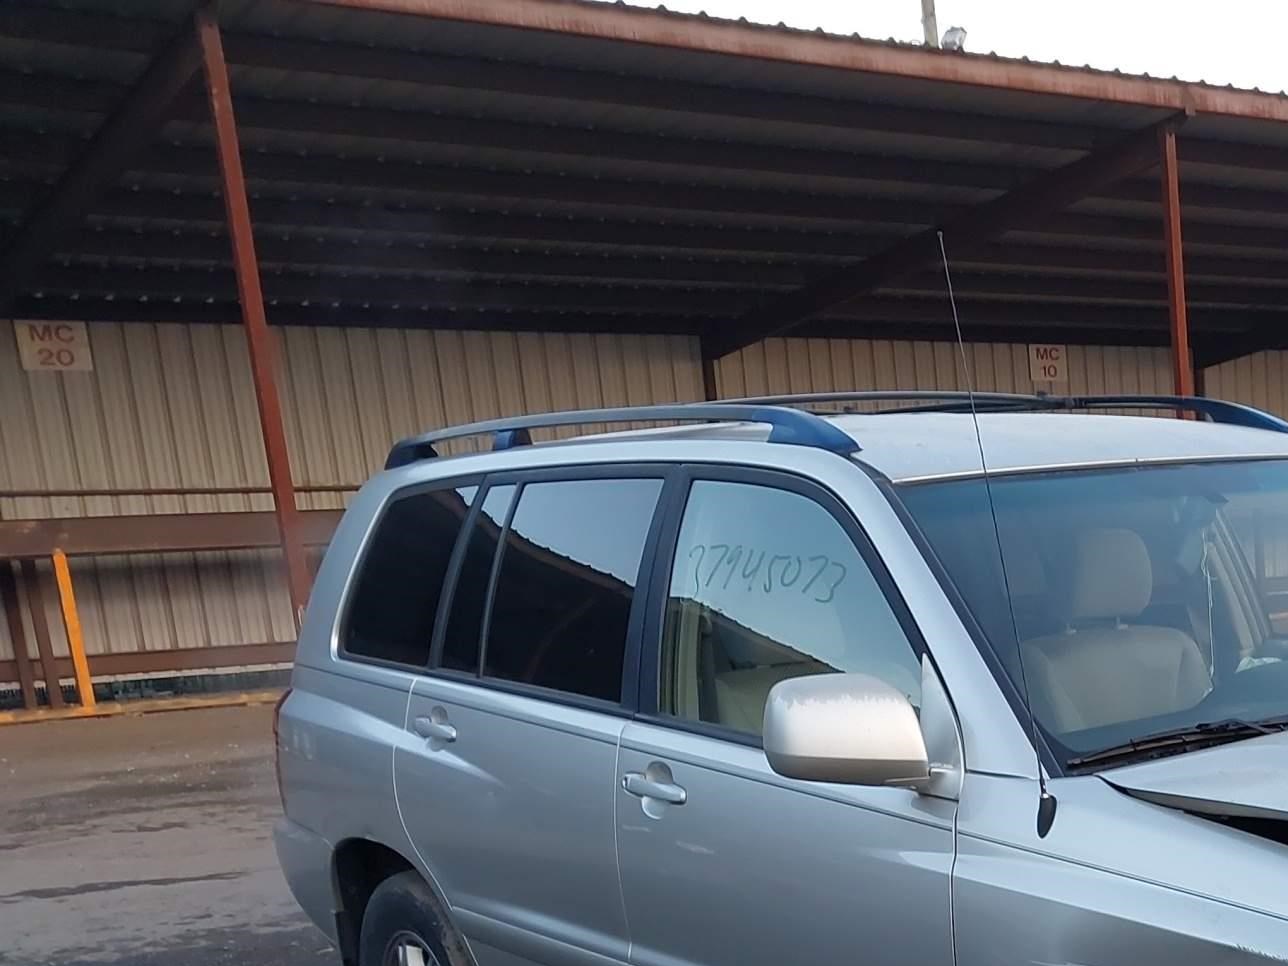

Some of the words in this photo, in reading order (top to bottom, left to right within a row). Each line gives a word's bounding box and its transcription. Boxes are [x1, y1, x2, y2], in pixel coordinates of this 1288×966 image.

[28, 324, 75, 342] MC
[37, 347, 75, 366] 20
[1036, 347, 1060, 361] MC
[1043, 364, 1057, 378] 10
